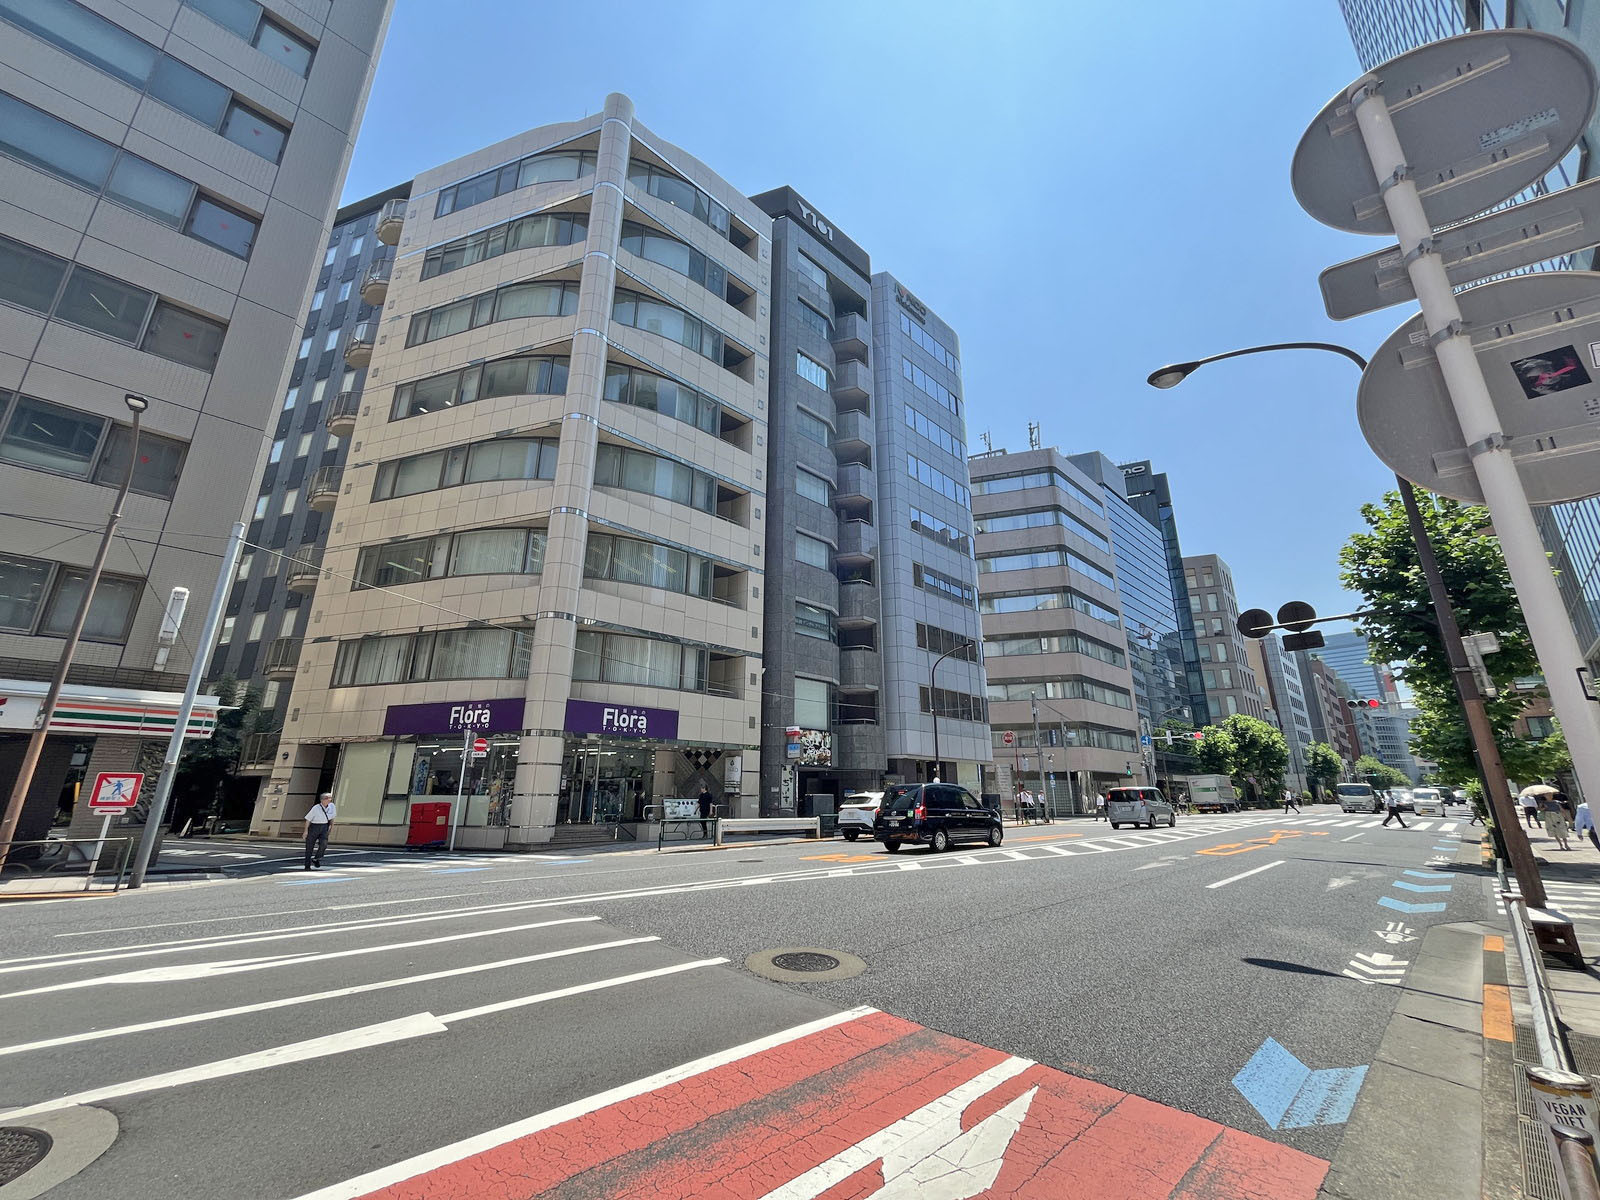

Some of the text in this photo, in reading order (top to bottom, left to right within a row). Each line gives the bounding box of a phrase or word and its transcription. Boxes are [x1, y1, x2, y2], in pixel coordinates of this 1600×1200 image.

[797, 199, 834, 242] Y101
[450, 706, 491, 725] Flora
[603, 707, 647, 728] Flora
[1543, 1100, 1587, 1116] VEGAN
[1554, 1114, 1585, 1129] DIET
